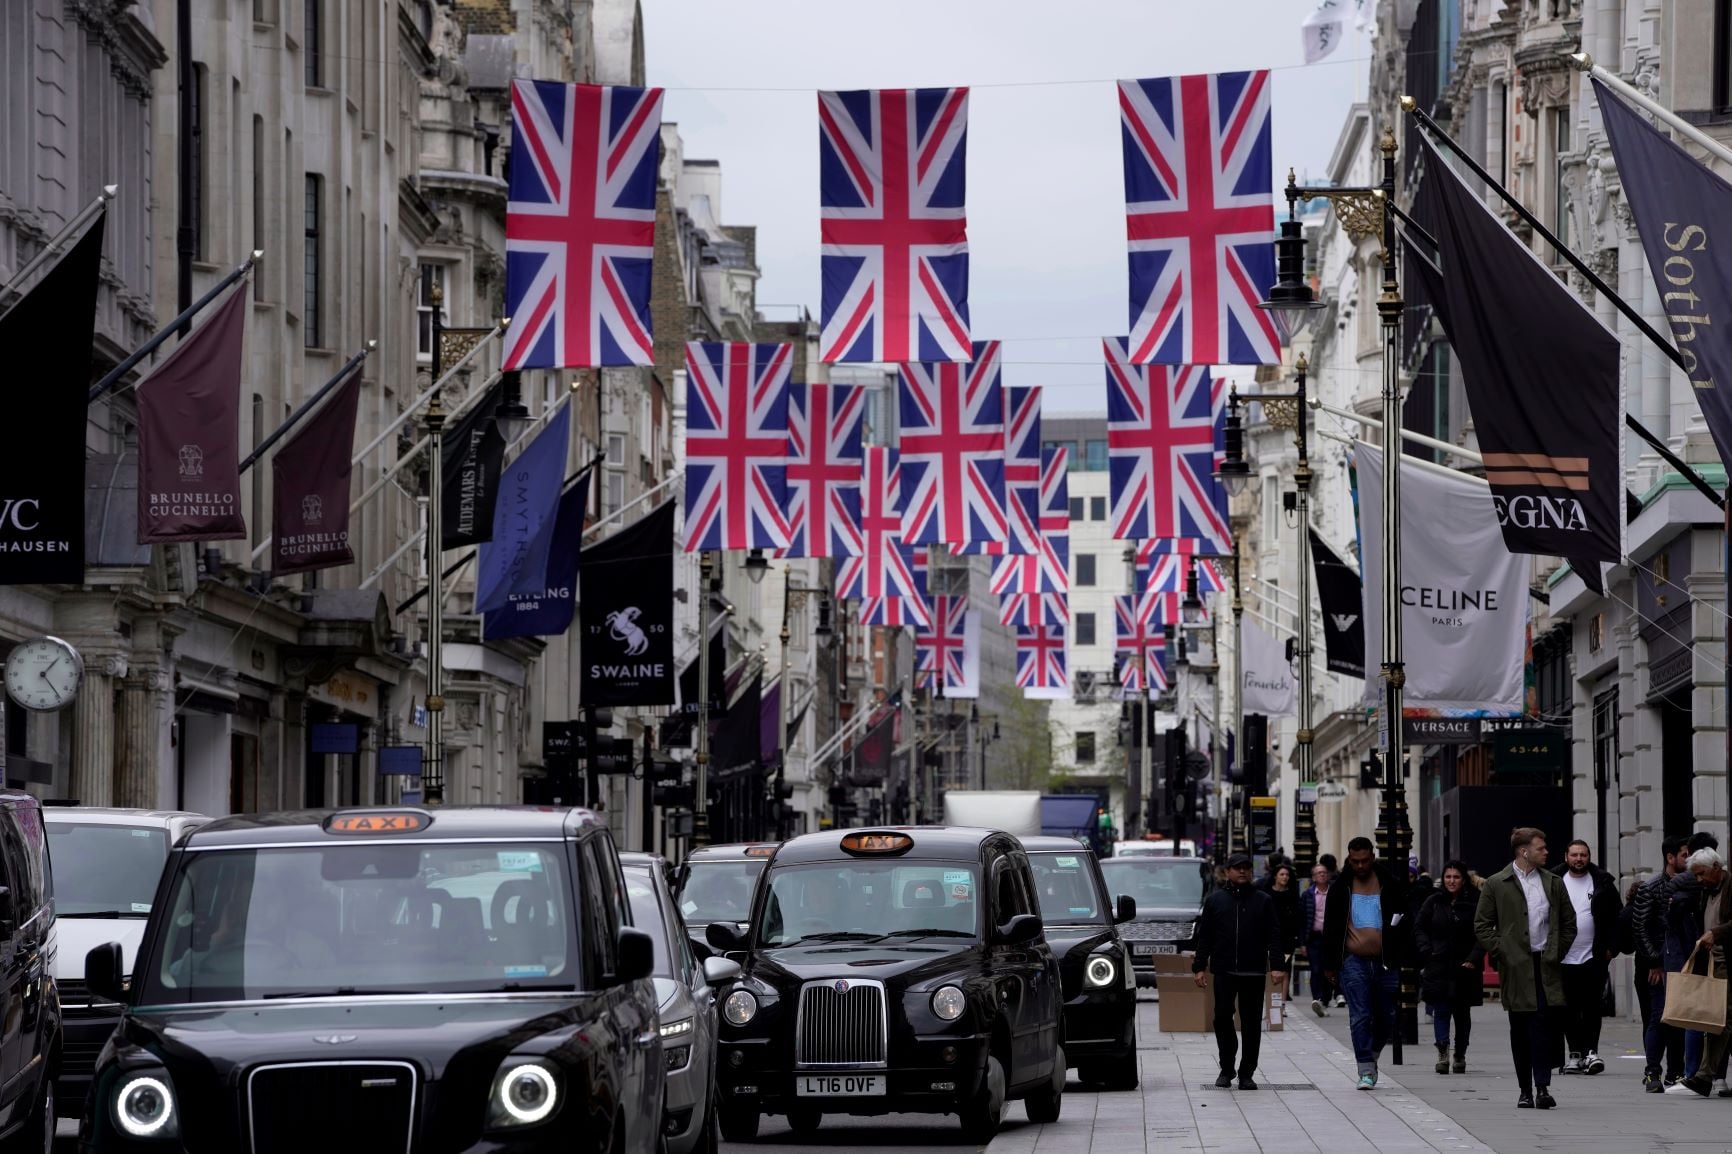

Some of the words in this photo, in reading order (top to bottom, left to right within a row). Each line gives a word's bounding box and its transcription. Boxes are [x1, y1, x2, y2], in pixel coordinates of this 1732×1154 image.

[150, 493, 234, 504] BRUNELLO
[457, 470, 475, 536] AUDEMARS
[149, 505, 234, 516] CUCINELLI
[281, 531, 348, 546] BRUNELLO
[1400, 586, 1498, 611] CELINE
[516, 602, 539, 611] 1884
[1432, 617, 1463, 626] PARIS
[590, 625, 601, 634] 17
[649, 624, 664, 633] 50
[591, 664, 664, 678] SWAINE
[1243, 670, 1290, 690] Fenwick
[1412, 722, 1471, 732] VERSACE
[1318, 787, 1347, 797] Fenwick
[341, 818, 410, 829] TAXI
[806, 1078, 840, 1093] LT16
[845, 1077, 876, 1092] OVF
